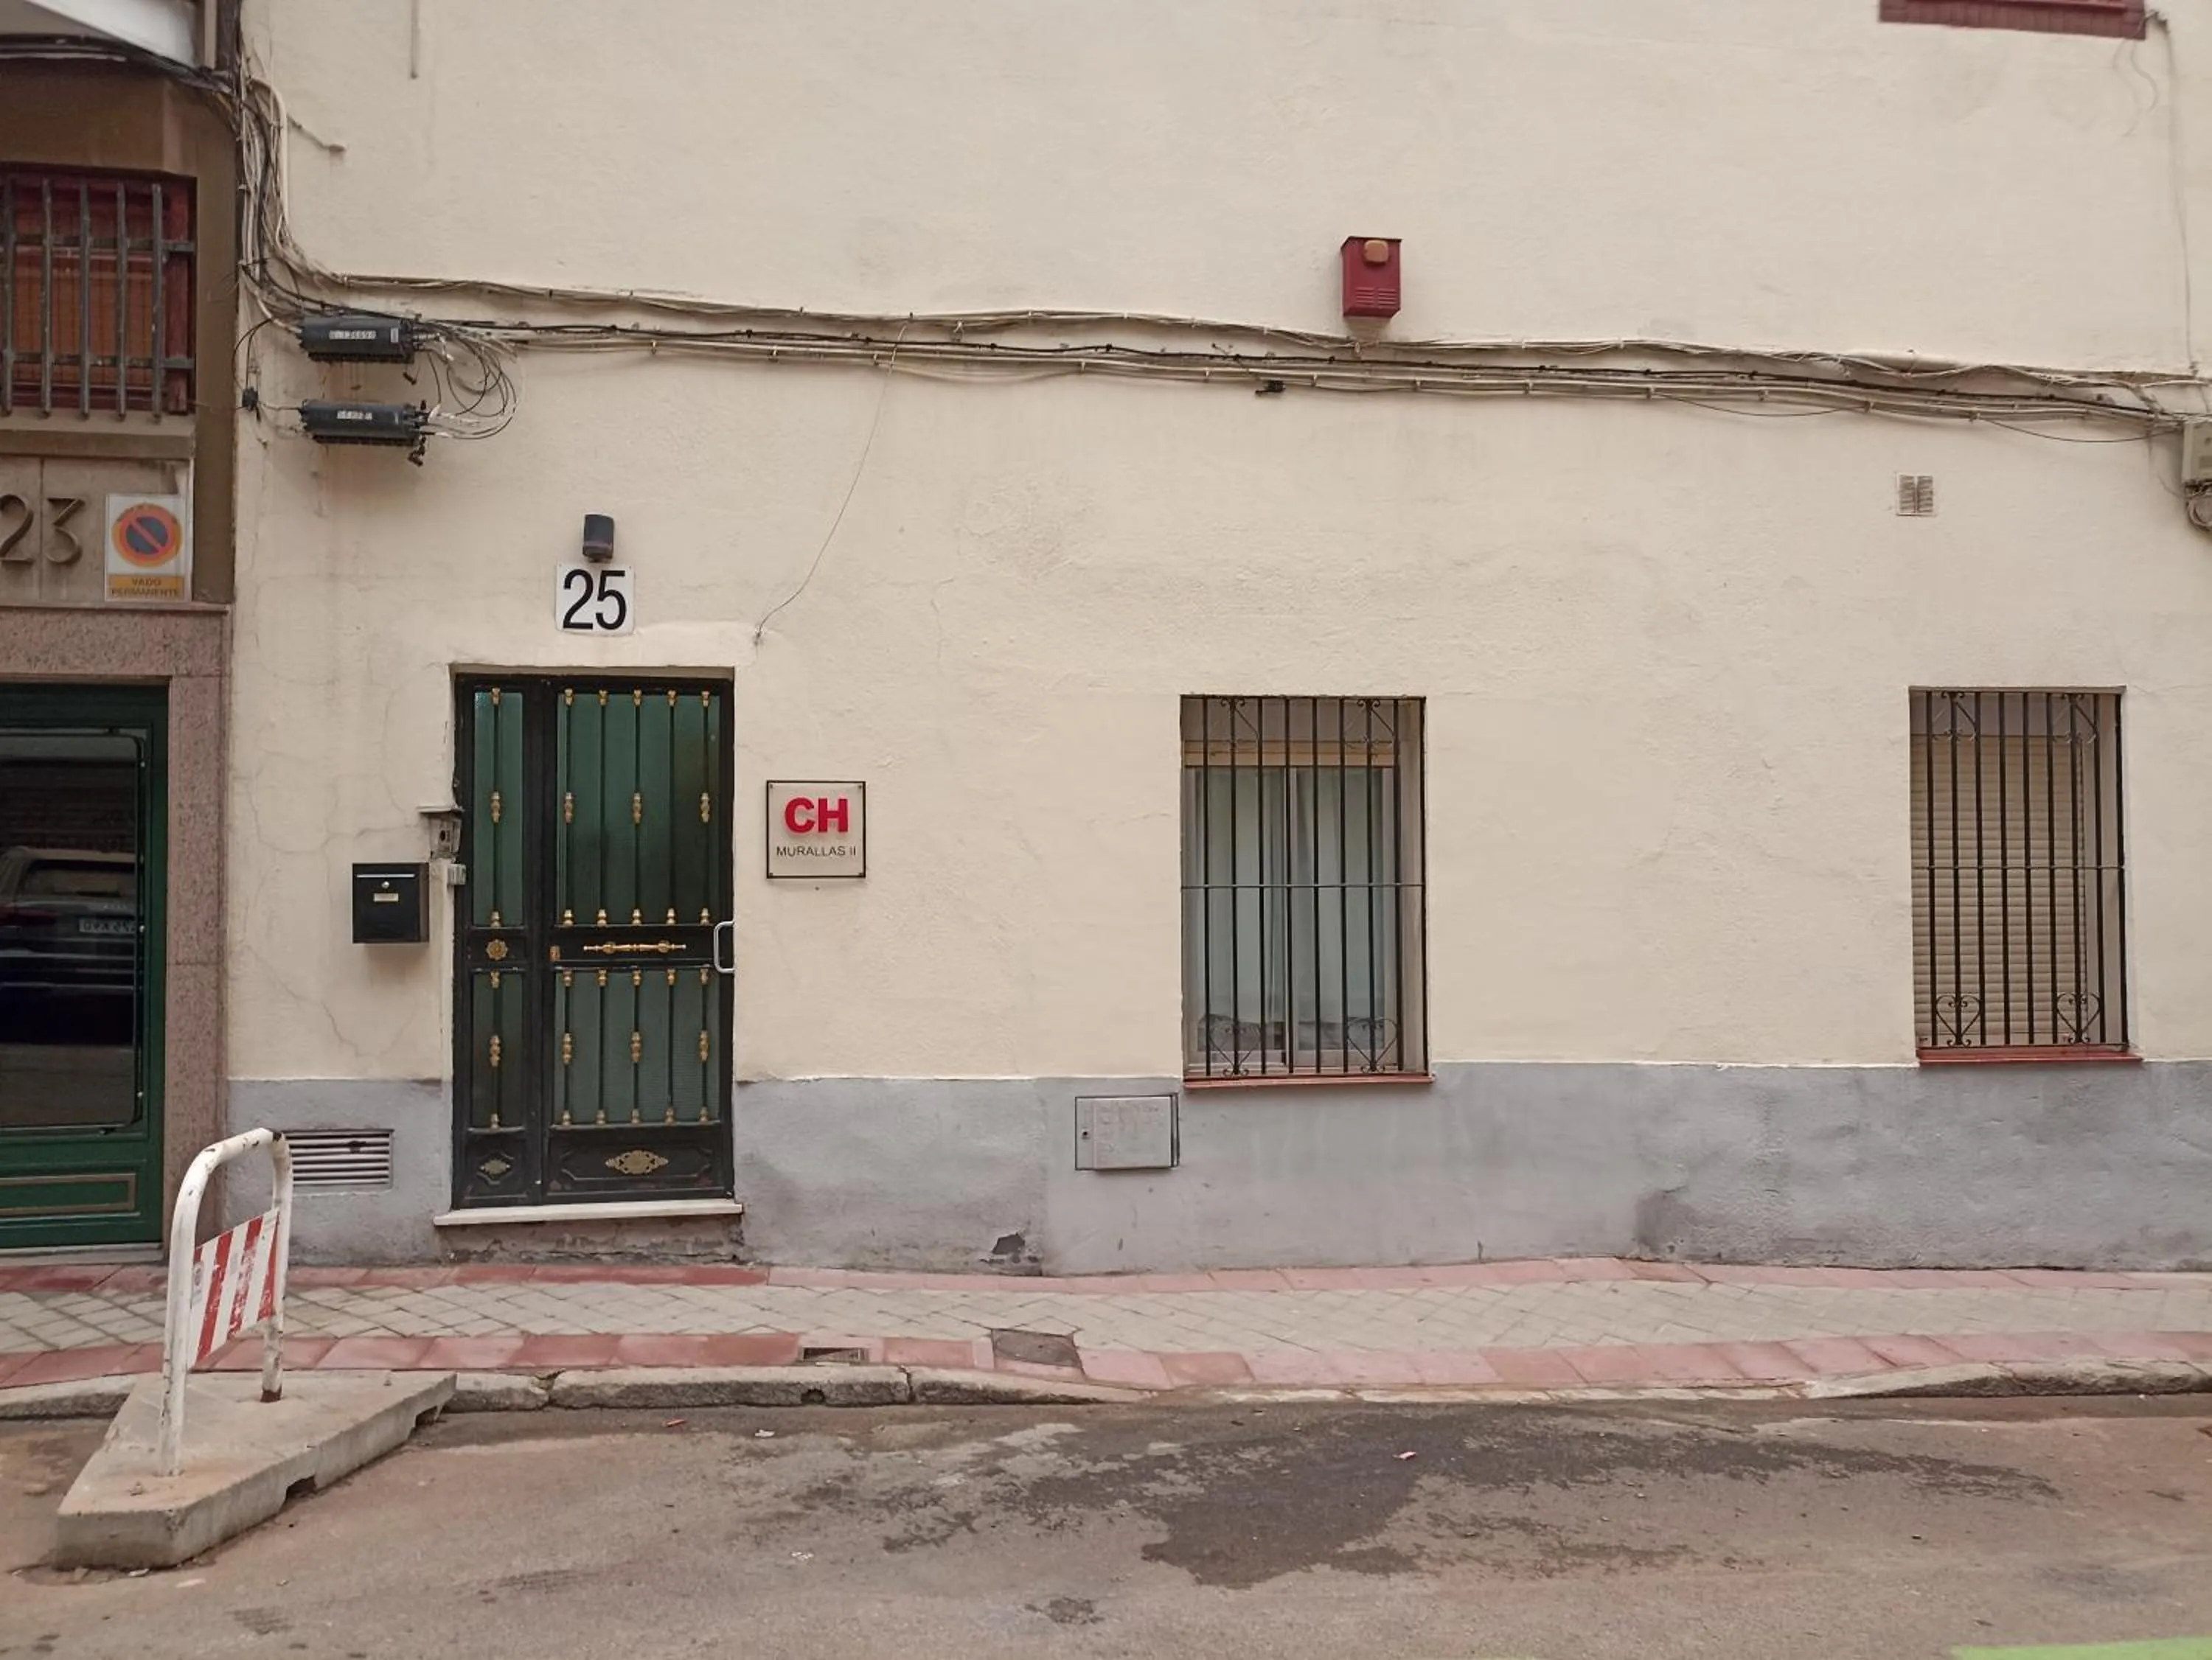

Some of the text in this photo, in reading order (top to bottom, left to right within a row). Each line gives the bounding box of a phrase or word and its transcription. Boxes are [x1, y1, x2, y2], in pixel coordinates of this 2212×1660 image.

[0, 495, 85, 564] 23
[563, 568, 627, 630] 25
[784, 797, 849, 834] CH
[776, 845, 857, 857] MURALLAS II
